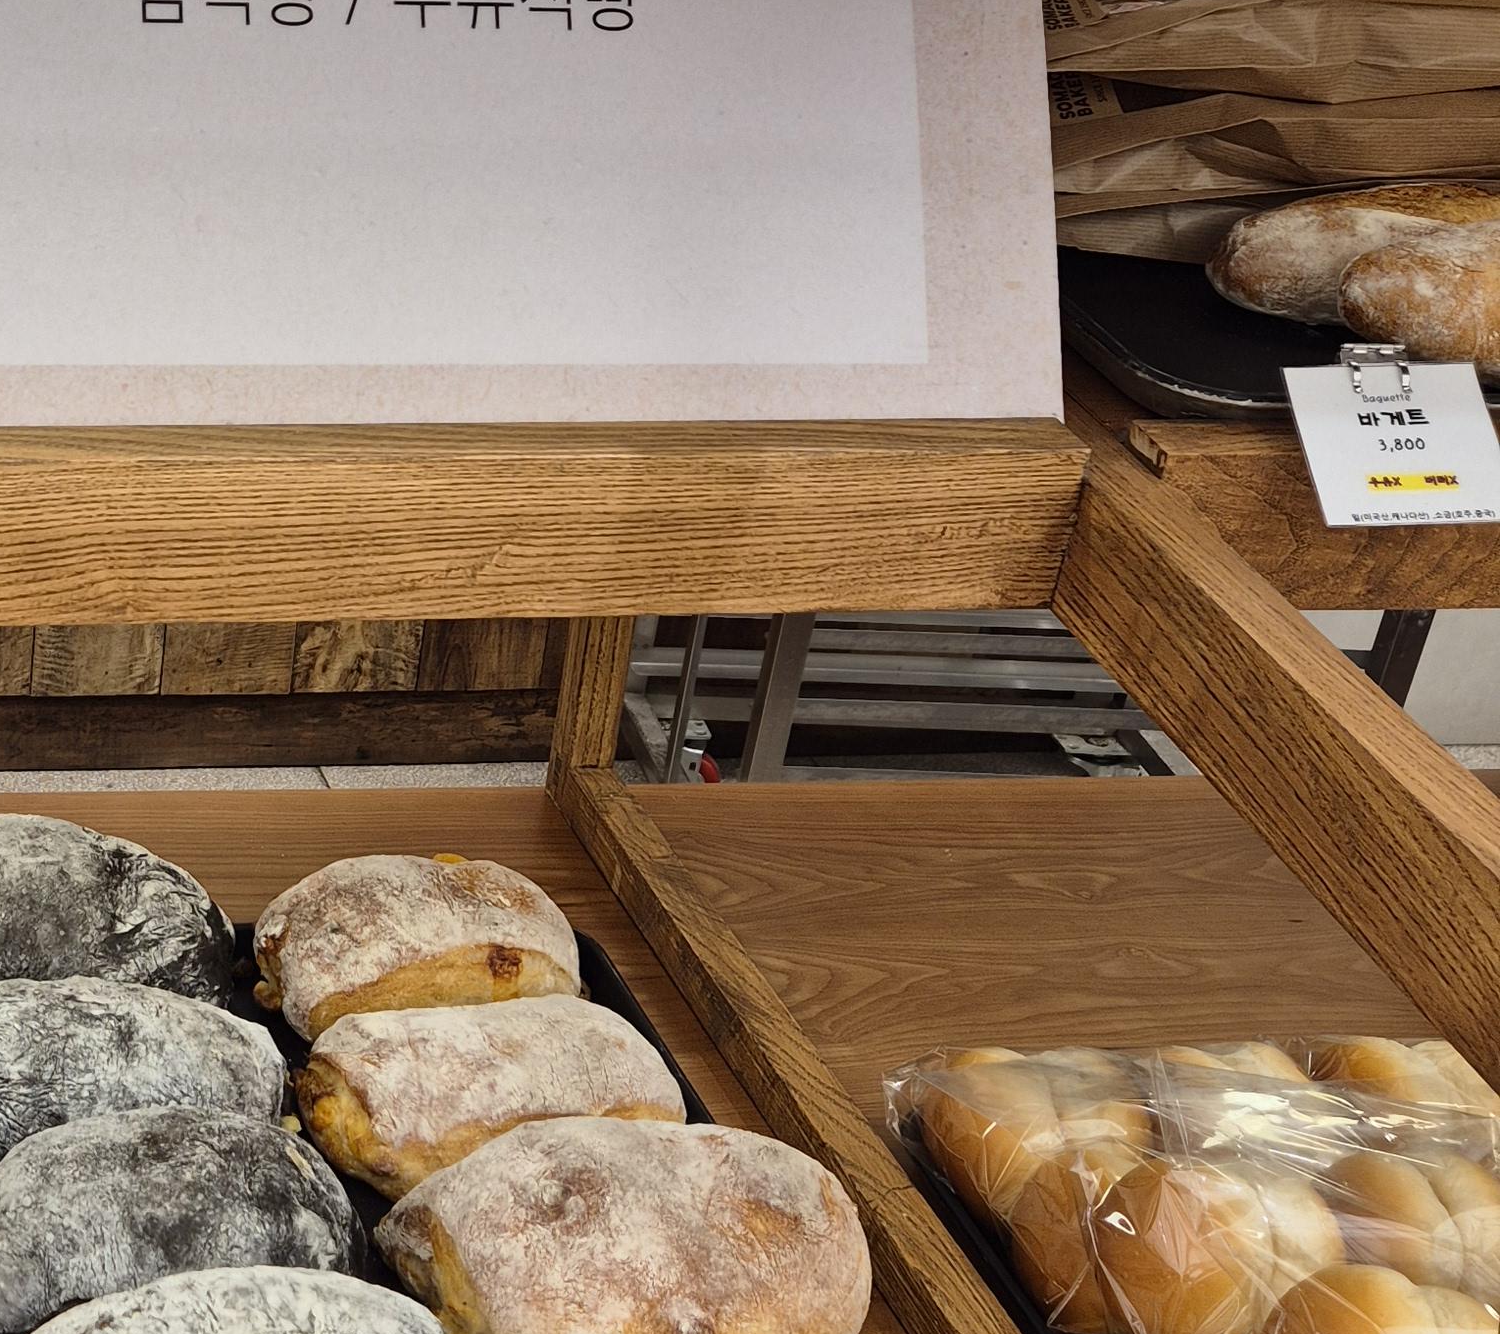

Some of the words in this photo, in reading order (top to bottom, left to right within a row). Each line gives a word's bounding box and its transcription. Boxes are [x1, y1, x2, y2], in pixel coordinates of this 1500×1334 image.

[1362, 393, 1411, 403] Baguette
[1357, 408, 1430, 426] 바게트
[1378, 437, 1426, 452] 3,800
